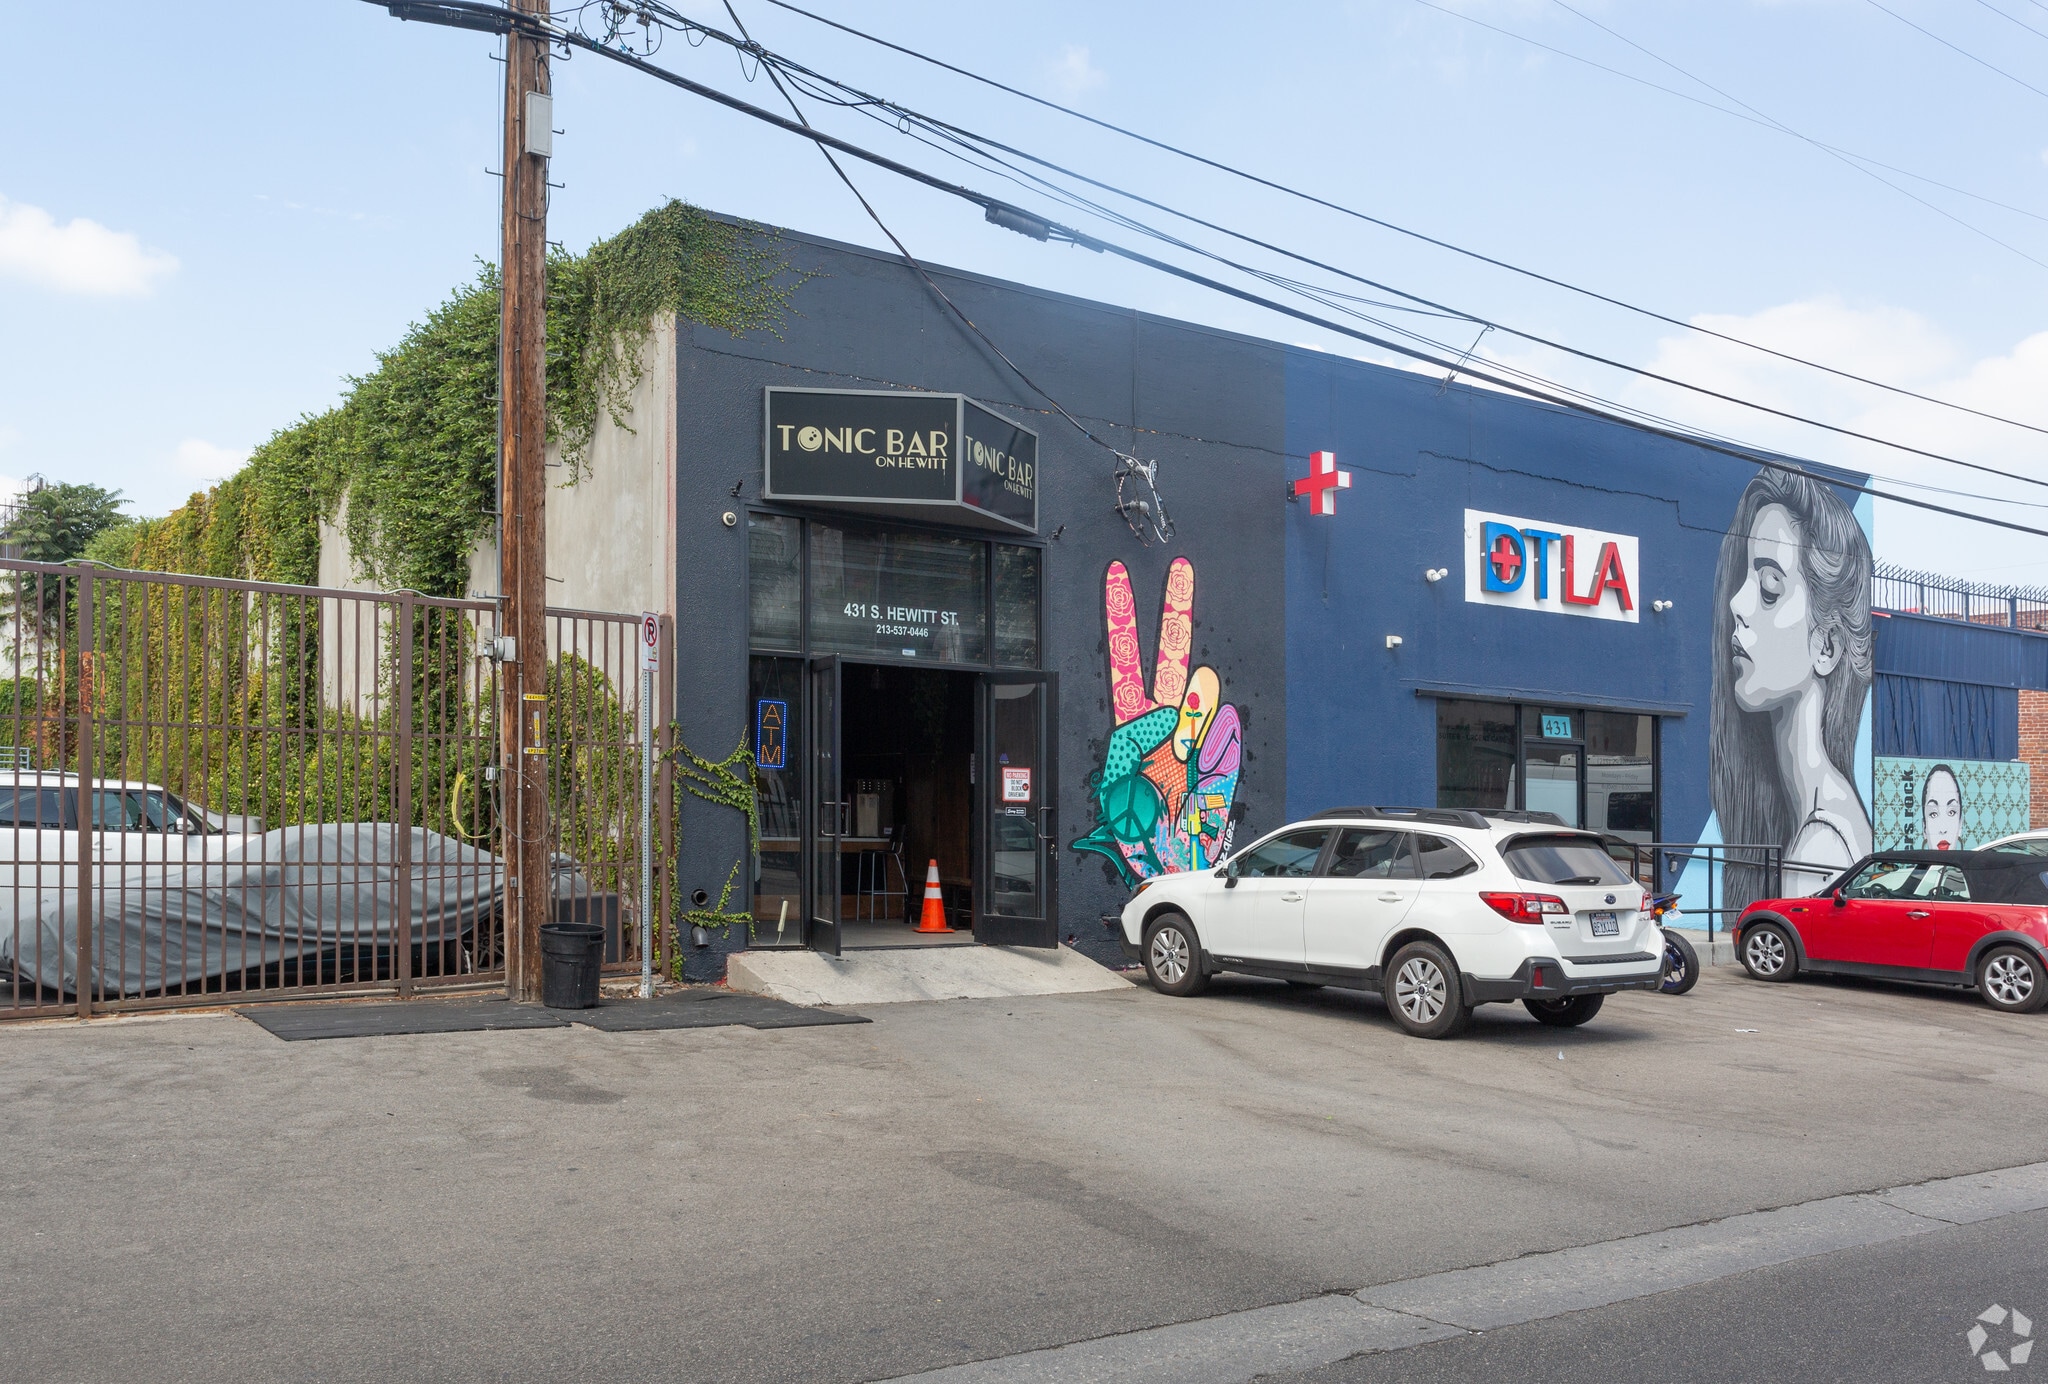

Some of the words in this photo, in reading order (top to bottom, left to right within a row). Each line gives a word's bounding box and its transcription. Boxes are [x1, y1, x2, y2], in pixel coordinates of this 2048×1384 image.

[776, 424, 876, 454] TONIC
[886, 429, 948, 457] BAR
[875, 456, 895, 468] ON
[899, 456, 948, 470] HEWITT
[965, 434, 1005, 476] TONIC
[1008, 458, 1033, 489] BAR
[1004, 480, 1013, 491] ON
[1013, 482, 1033, 500] HEWITT
[1480, 521, 1634, 611] DTLA
[843, 602, 866, 618] 431
[871, 604, 883, 620] S.
[887, 606, 938, 624] HEWITT
[940, 610, 959, 626] ST.
[876, 624, 929, 638] 213-537-0446
[761, 704, 781, 765] ATM
[1545, 719, 1570, 737] 431
[1902, 770, 1914, 818] rock
